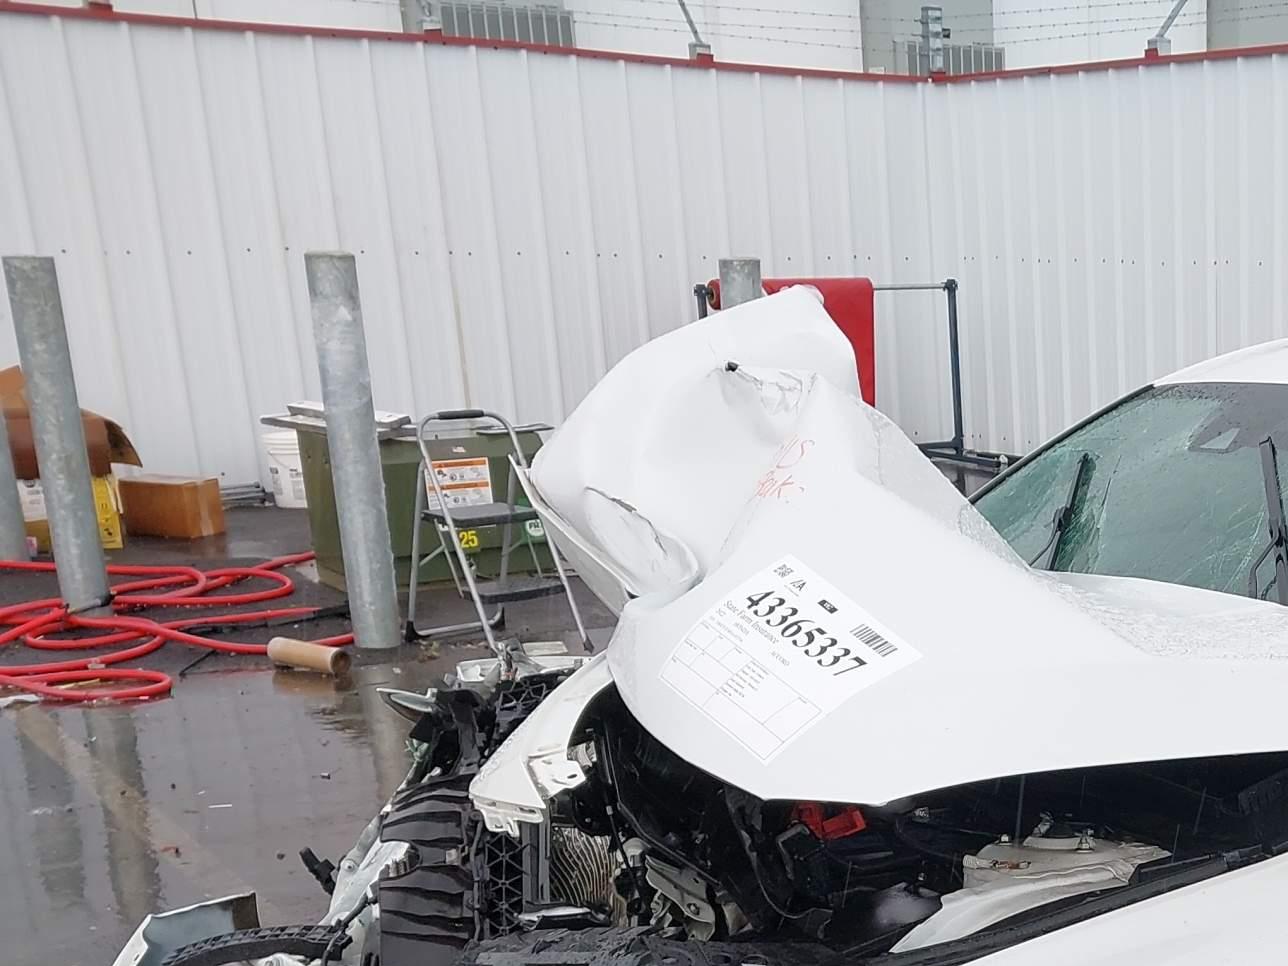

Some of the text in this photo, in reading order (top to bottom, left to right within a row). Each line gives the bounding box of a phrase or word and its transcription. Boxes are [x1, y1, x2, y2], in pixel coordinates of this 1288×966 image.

[459, 530, 479, 548] 25
[723, 599, 738, 615] State
[736, 607, 754, 627] Farm
[751, 620, 780, 645] Insurance
[745, 590, 868, 677] 43365337
